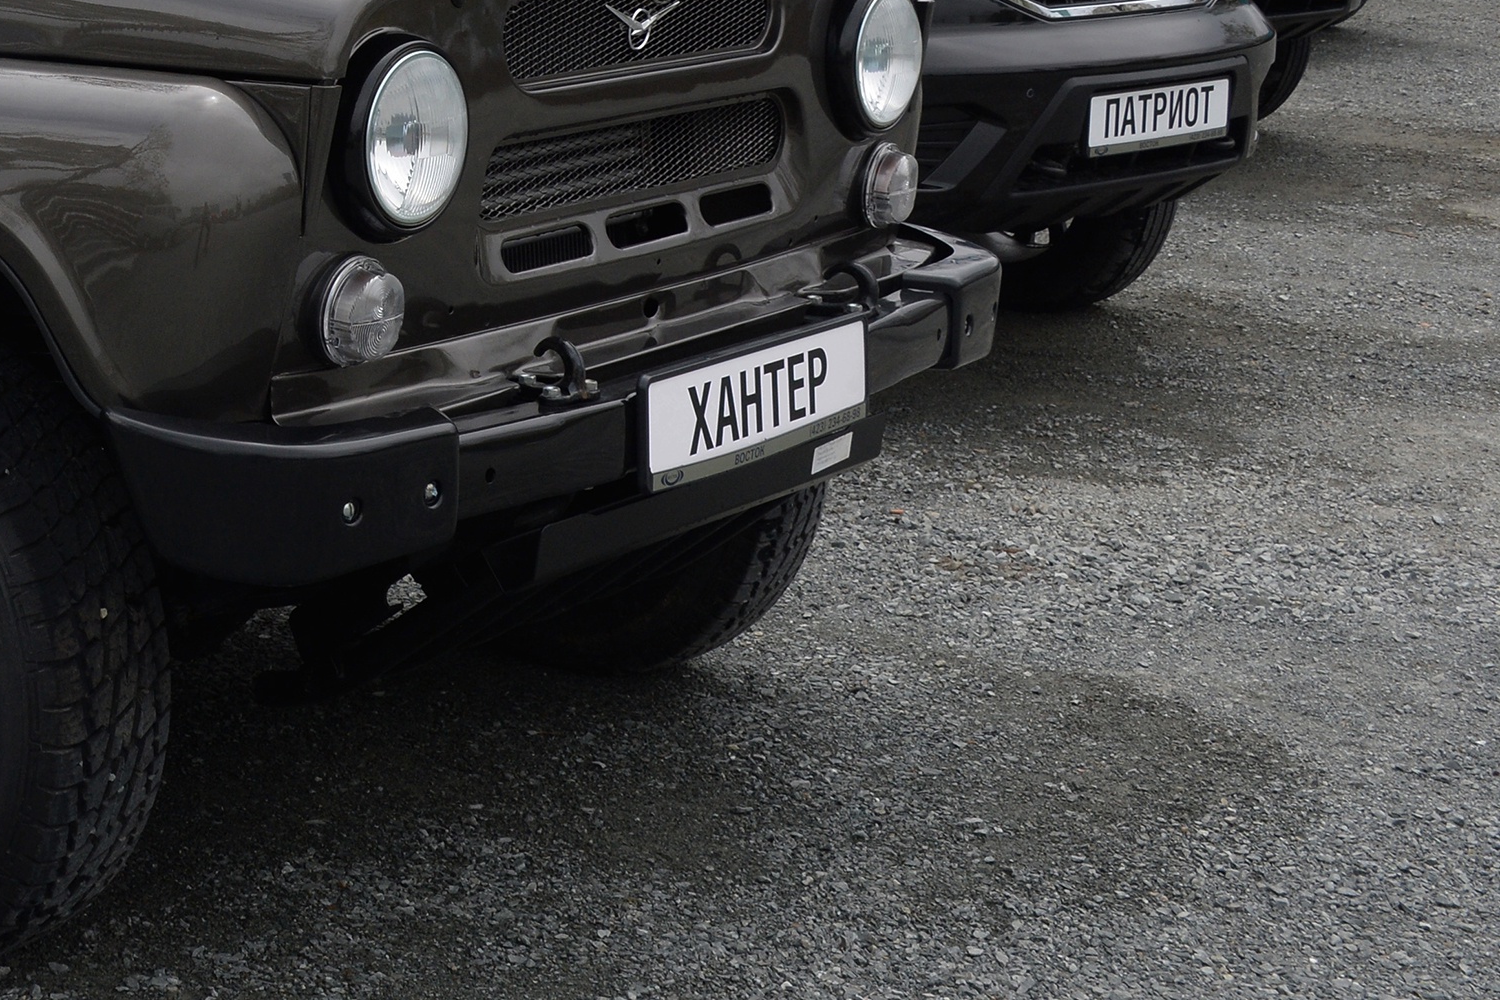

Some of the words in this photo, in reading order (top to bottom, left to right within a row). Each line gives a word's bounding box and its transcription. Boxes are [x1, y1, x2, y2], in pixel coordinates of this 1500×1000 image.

[1104, 85, 1215, 139] ПАТРИОТ
[687, 346, 828, 457] ХАНТЕР
[734, 444, 766, 466] ВОСТОК
